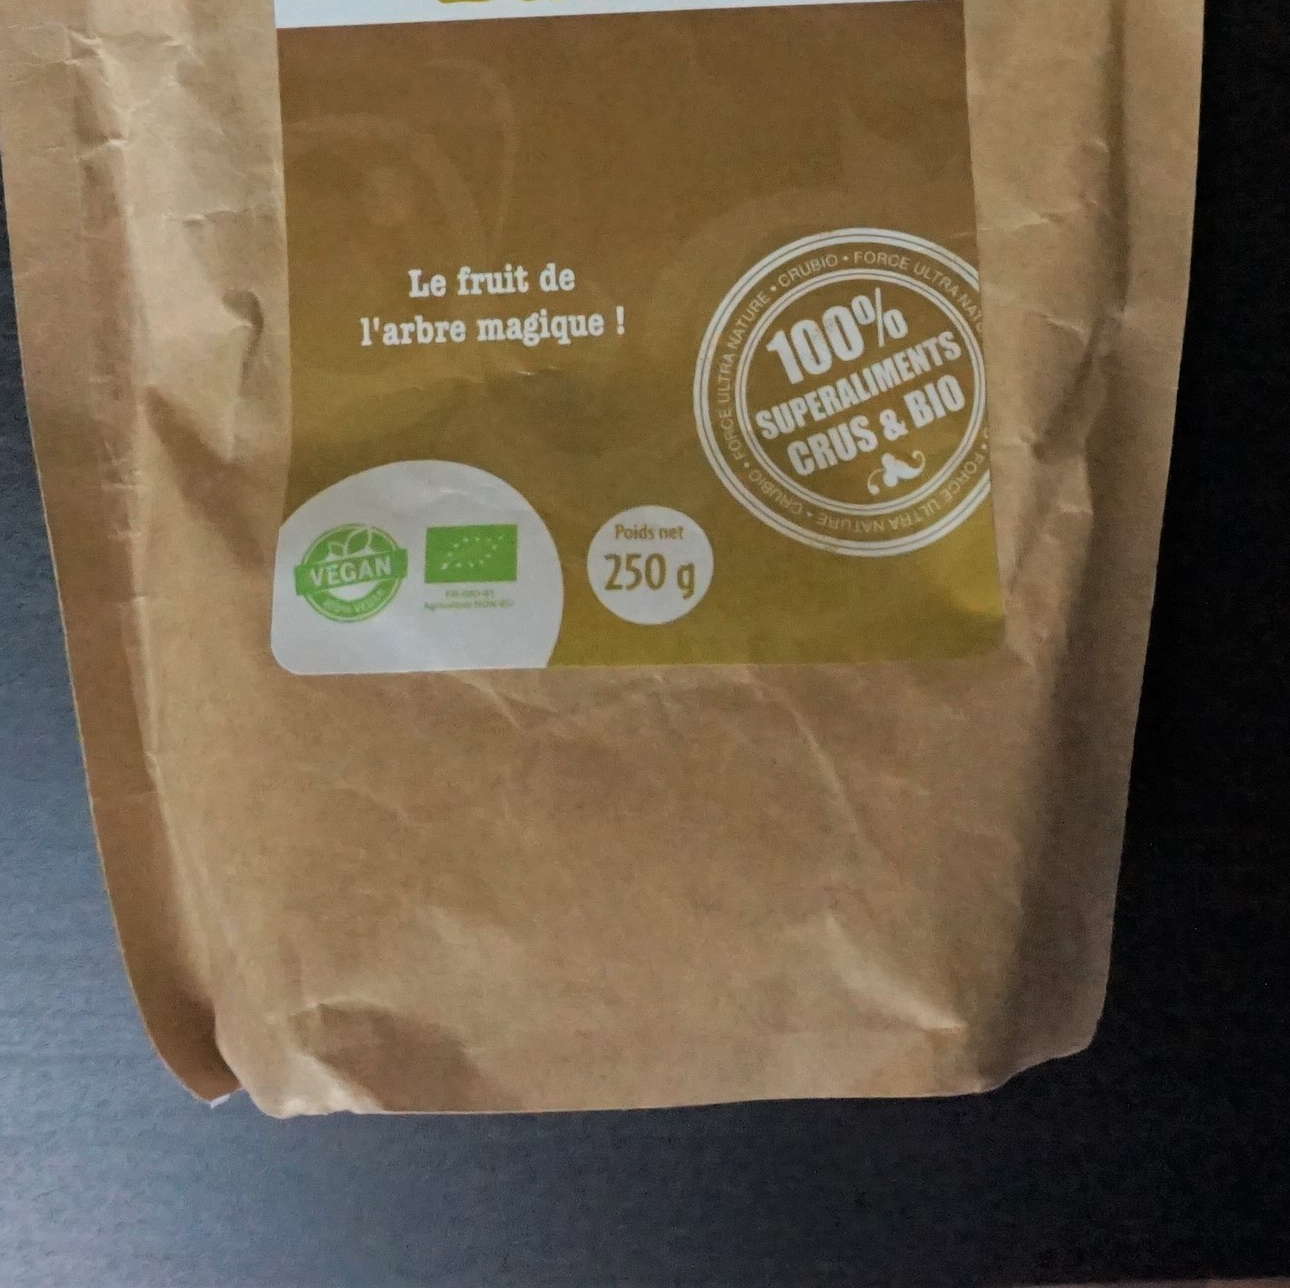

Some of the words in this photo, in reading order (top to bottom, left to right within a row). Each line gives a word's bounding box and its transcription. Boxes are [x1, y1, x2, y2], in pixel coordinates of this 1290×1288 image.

[408, 269, 447, 298] Le
[457, 263, 529, 295] fruit
[539, 263, 576, 292] de
[778, 253, 838, 287] CRUBIO
[853, 251, 910, 270] FORCE
[914, 262, 959, 297] ULTRA
[360, 315, 466, 346] l'arbre
[477, 308, 605, 347] magique
[615, 305, 626, 335] !
[727, 293, 770, 349] NATURE
[766, 287, 908, 385] 100%
[718, 352, 735, 404] ULTRA
[755, 331, 962, 440] SUPERALIMENTS
[722, 408, 742, 460] FORCE
[787, 415, 878, 477] CRUS
[879, 409, 909, 441] &
[903, 374, 966, 429] BIO
[940, 453, 985, 502] FORCE
[615, 524, 654, 541] Poids
[659, 525, 684, 540] net
[311, 557, 391, 586] VEGAN
[604, 554, 666, 591] 250
[677, 562, 696, 599] g
